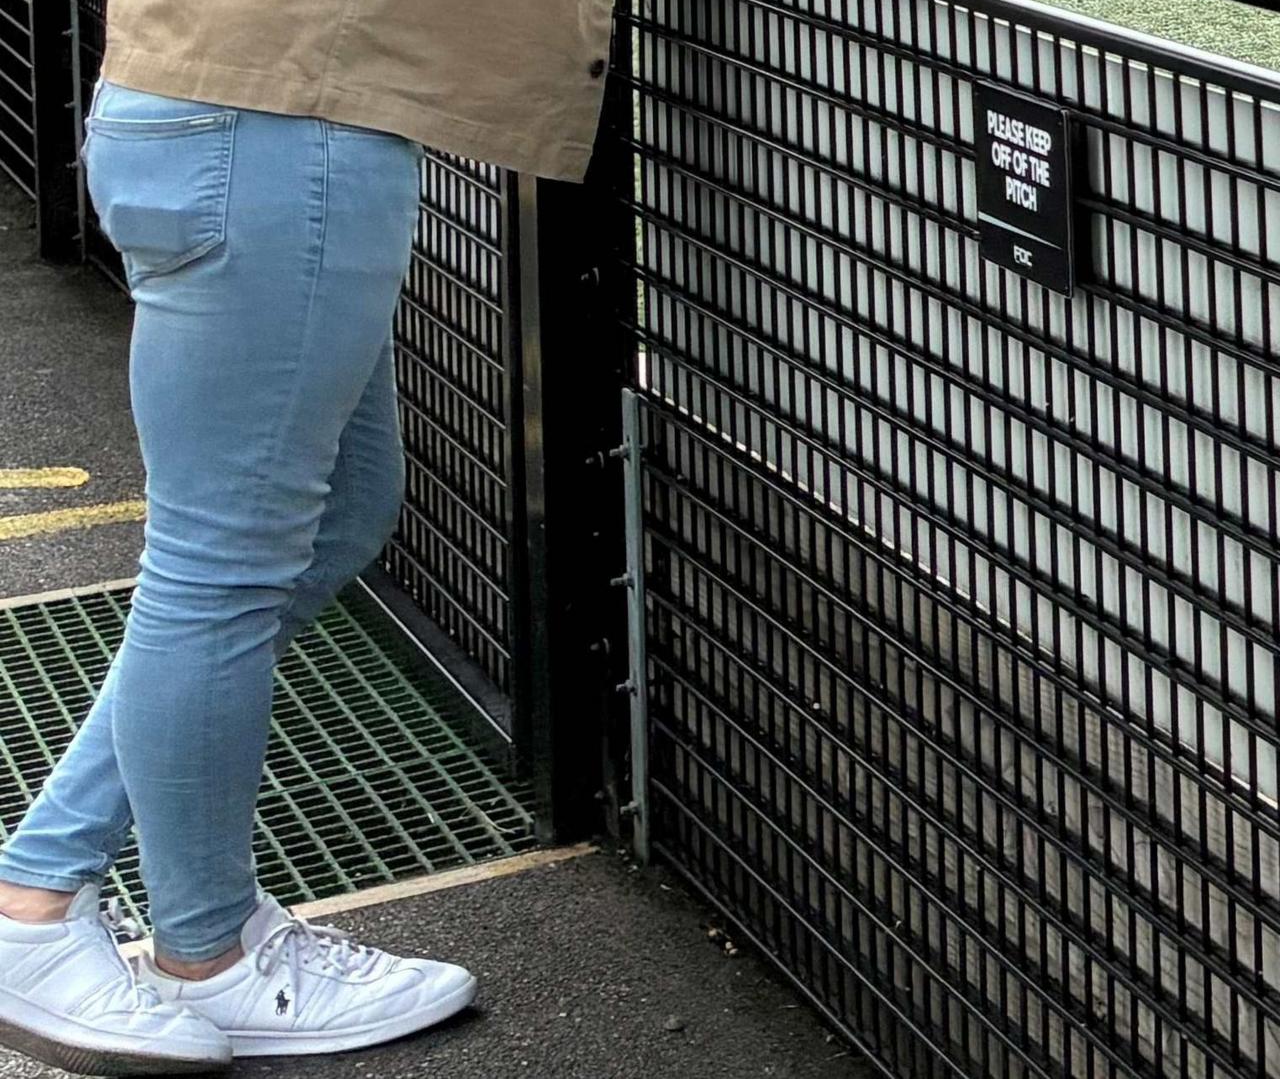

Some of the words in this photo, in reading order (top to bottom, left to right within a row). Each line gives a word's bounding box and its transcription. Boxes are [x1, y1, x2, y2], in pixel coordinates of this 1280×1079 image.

[987, 109, 1024, 146] PLEASE
[1025, 124, 1052, 157] KEEP
[991, 141, 1012, 170] OFF
[1013, 149, 1029, 177] OF
[1029, 156, 1050, 188] THE
[1005, 175, 1037, 212] PITCH
